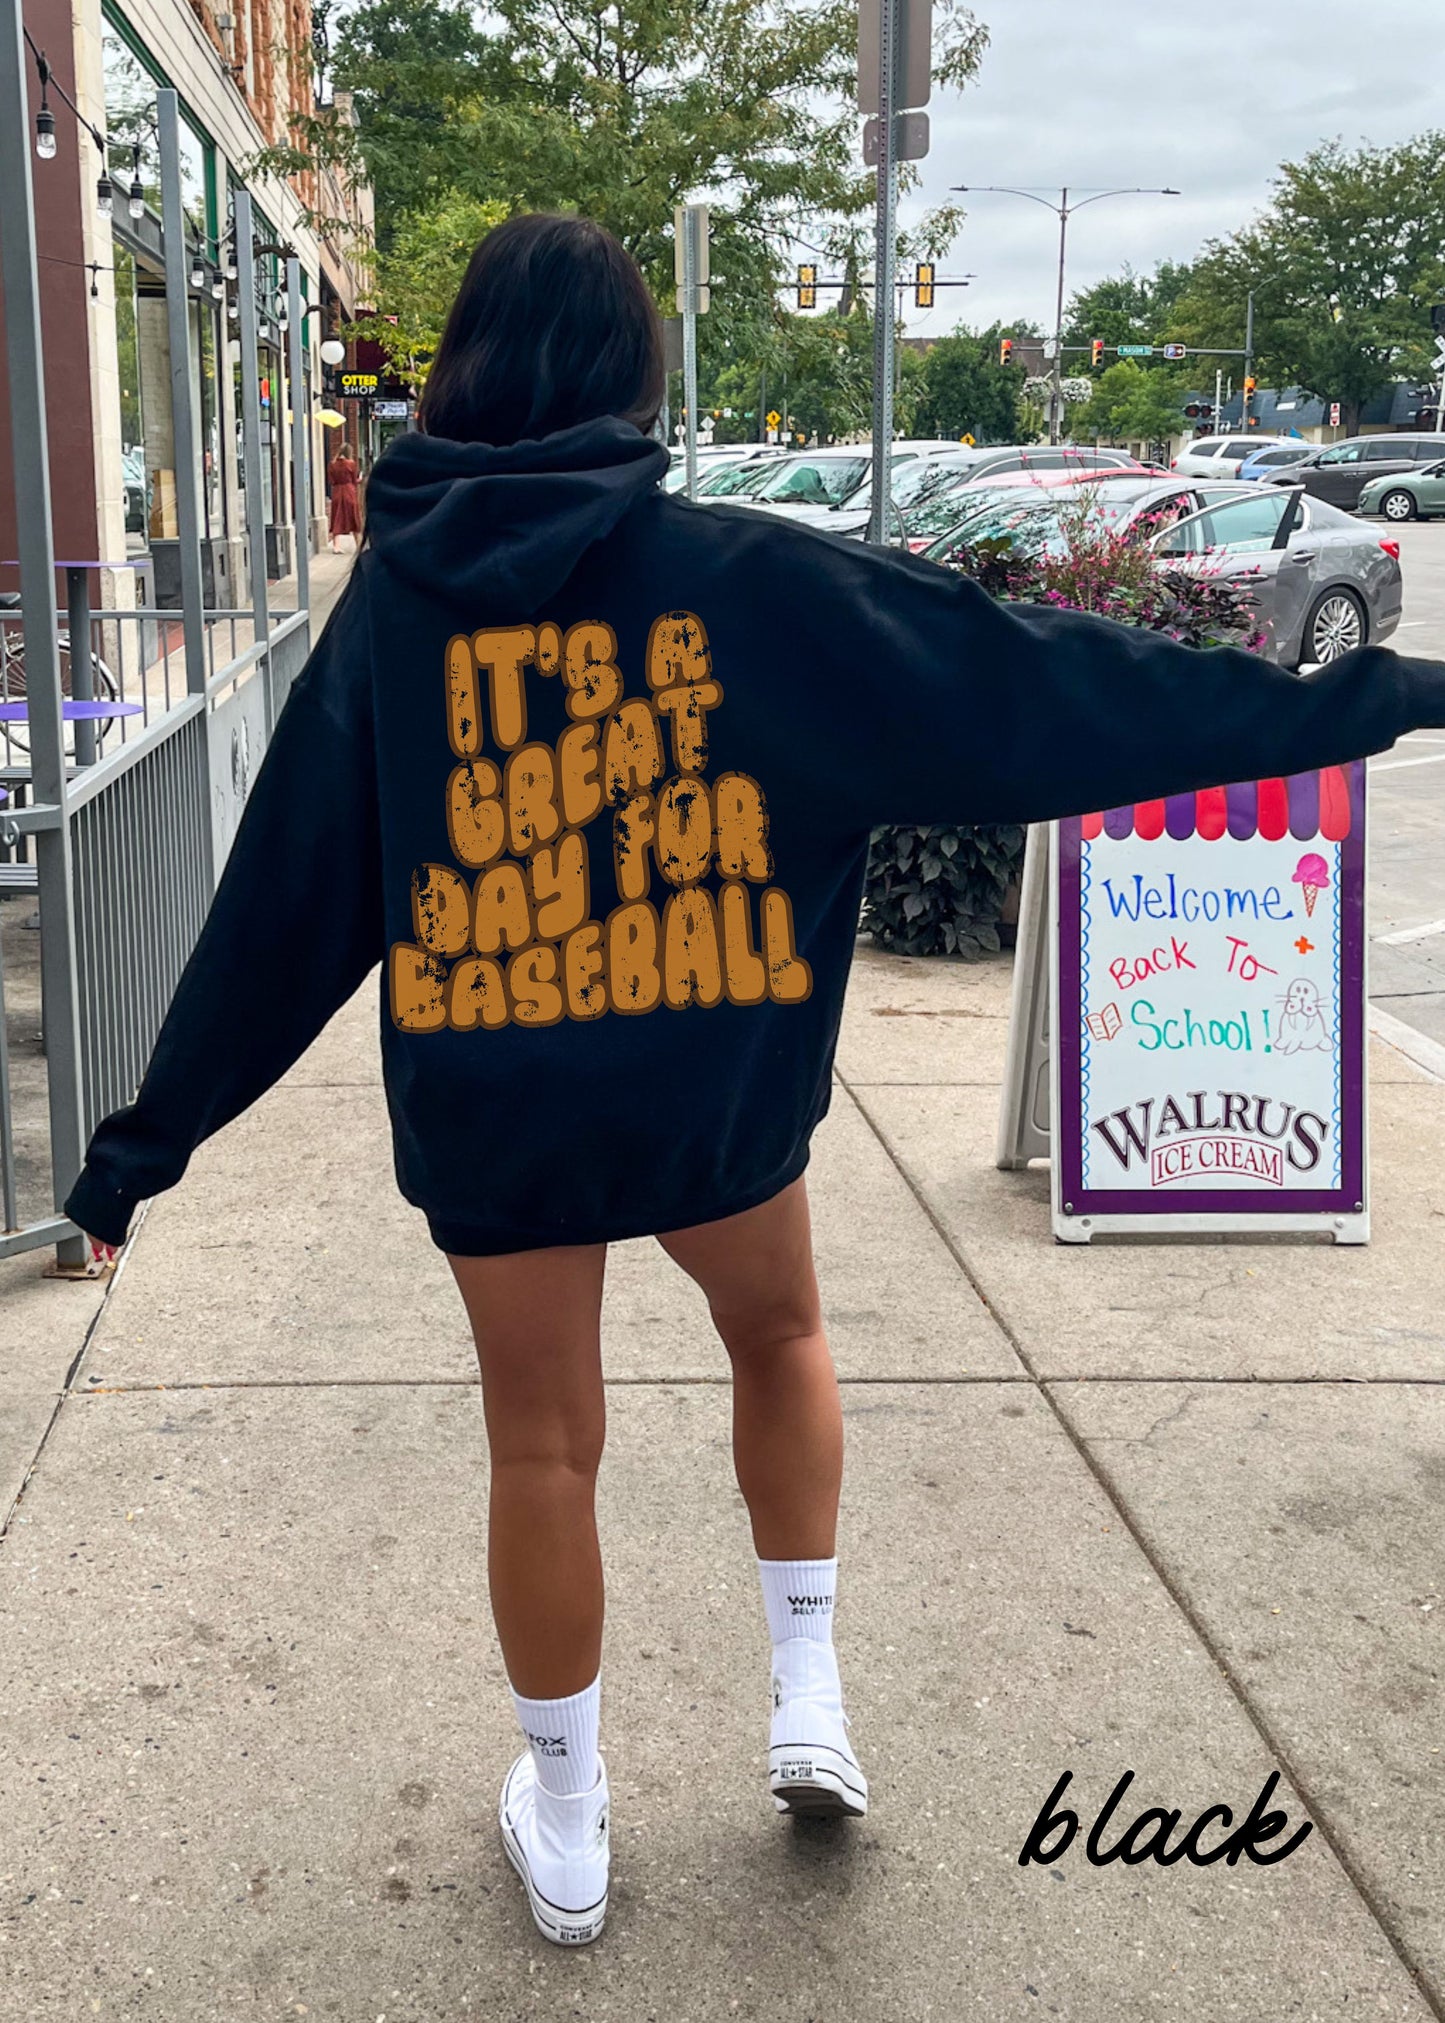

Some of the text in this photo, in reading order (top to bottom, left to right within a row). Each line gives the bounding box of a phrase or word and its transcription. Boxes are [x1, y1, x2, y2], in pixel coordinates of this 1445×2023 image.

[341, 374, 378, 386] OTTER
[343, 386, 376, 395] SHOP
[444, 610, 713, 759] IT'S A
[446, 679, 724, 869] GREAT
[411, 771, 776, 958] DAY FOR
[1101, 873, 1294, 922] Welcome
[389, 879, 813, 1034] BASEBALL
[1225, 935, 1279, 981] To
[1130, 999, 1272, 1053] School!
[1090, 1091, 1330, 1172] WALRUS
[1156, 1140, 1279, 1180] ICE CREAM
[541, 1747, 568, 1757] CLUB
[780, 1766, 813, 1779] ALL STAR
